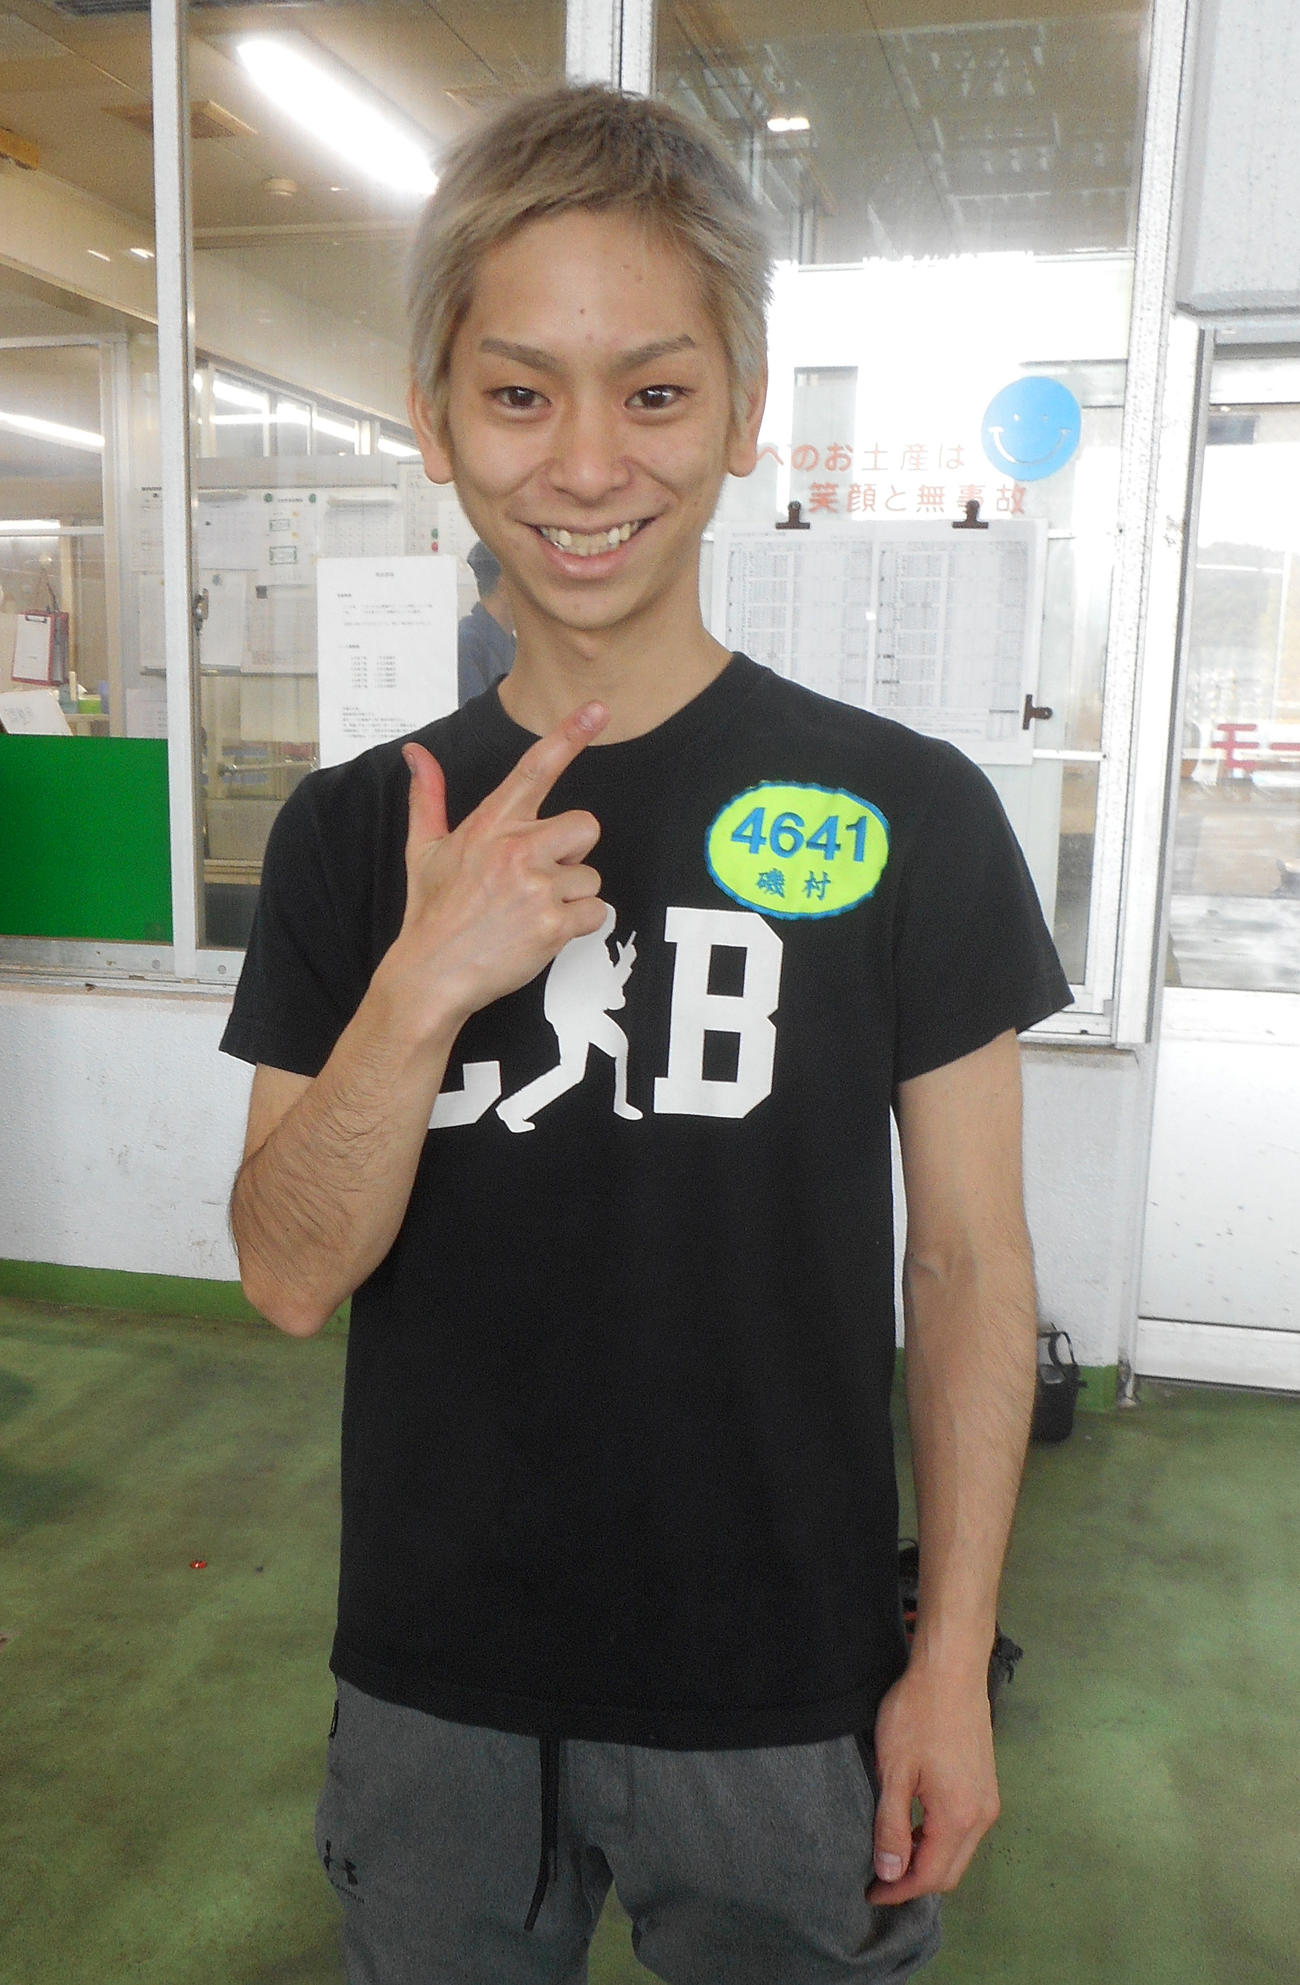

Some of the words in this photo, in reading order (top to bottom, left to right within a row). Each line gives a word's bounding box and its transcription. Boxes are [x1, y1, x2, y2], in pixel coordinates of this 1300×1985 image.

[809, 482, 1026, 515] 笑顔と無事故
[731, 807, 867, 862] 4641
[654, 906, 784, 1119] B
